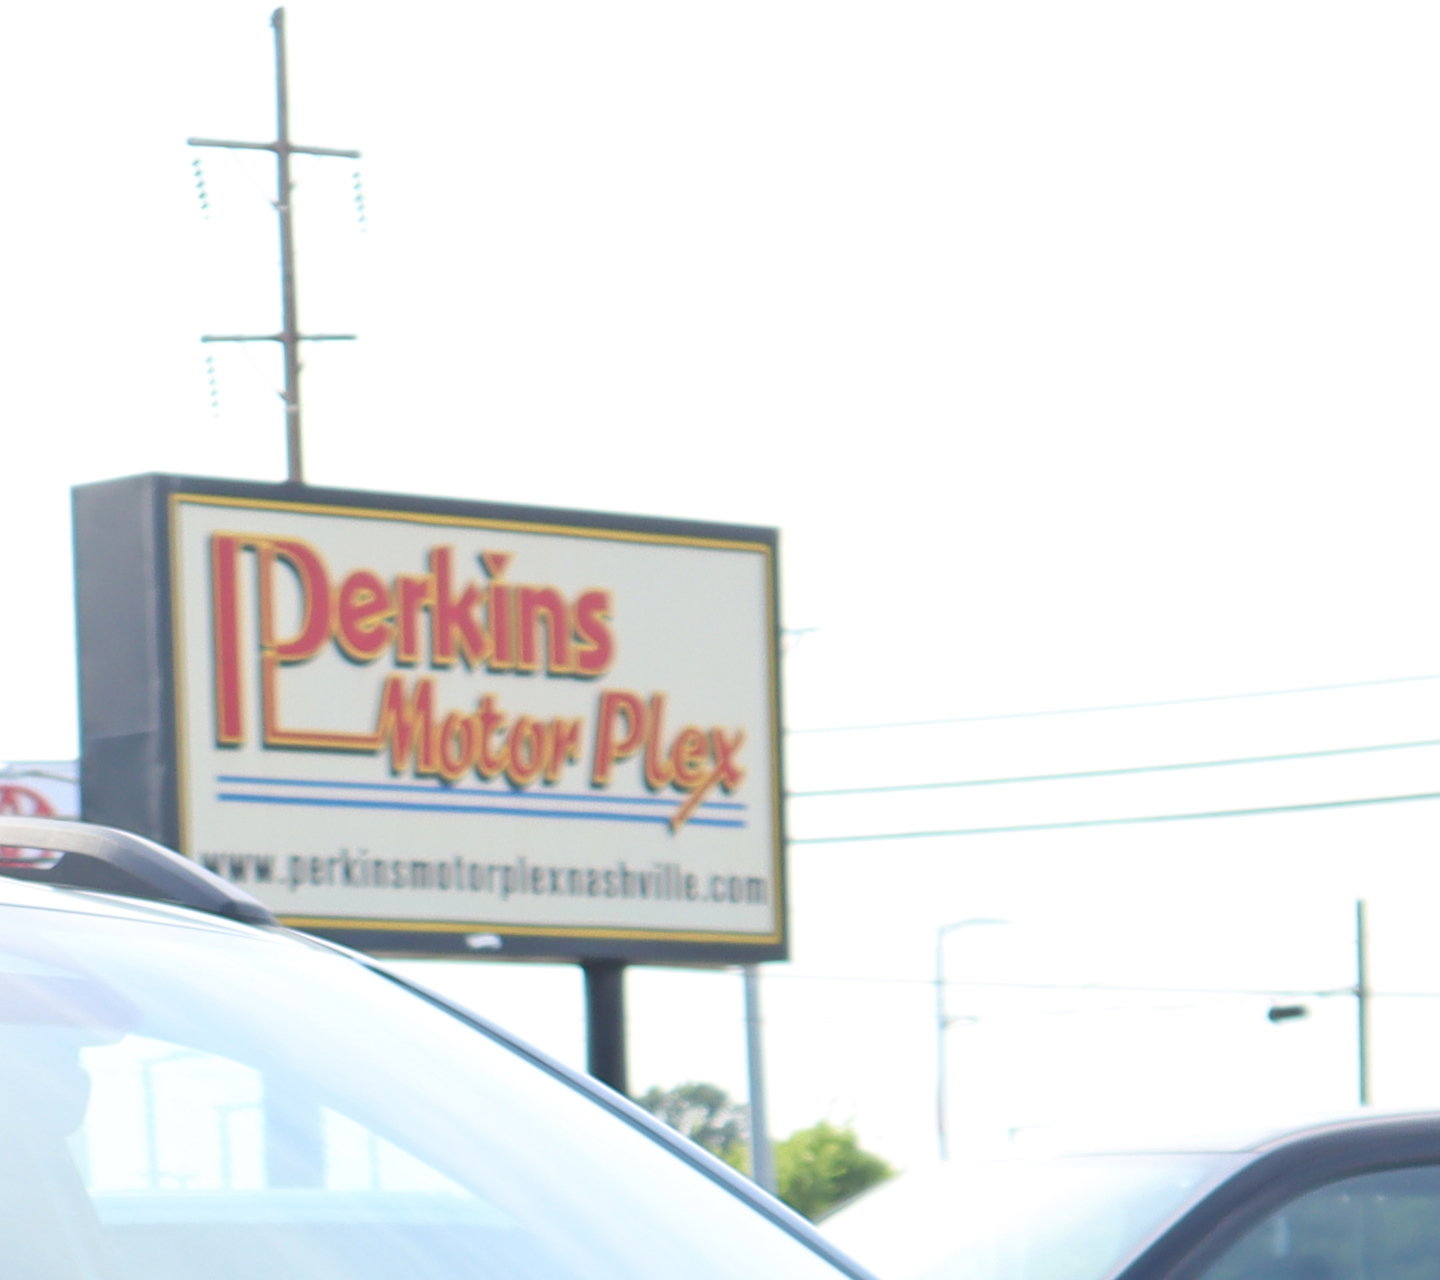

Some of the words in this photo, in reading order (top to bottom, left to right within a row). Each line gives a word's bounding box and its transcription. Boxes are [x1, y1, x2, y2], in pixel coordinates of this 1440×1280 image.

[211, 531, 615, 746] Perkins
[377, 672, 582, 785] Motor
[590, 689, 748, 834] Plex
[198, 848, 769, 905] www.perkinsmotorplexnashville.com
